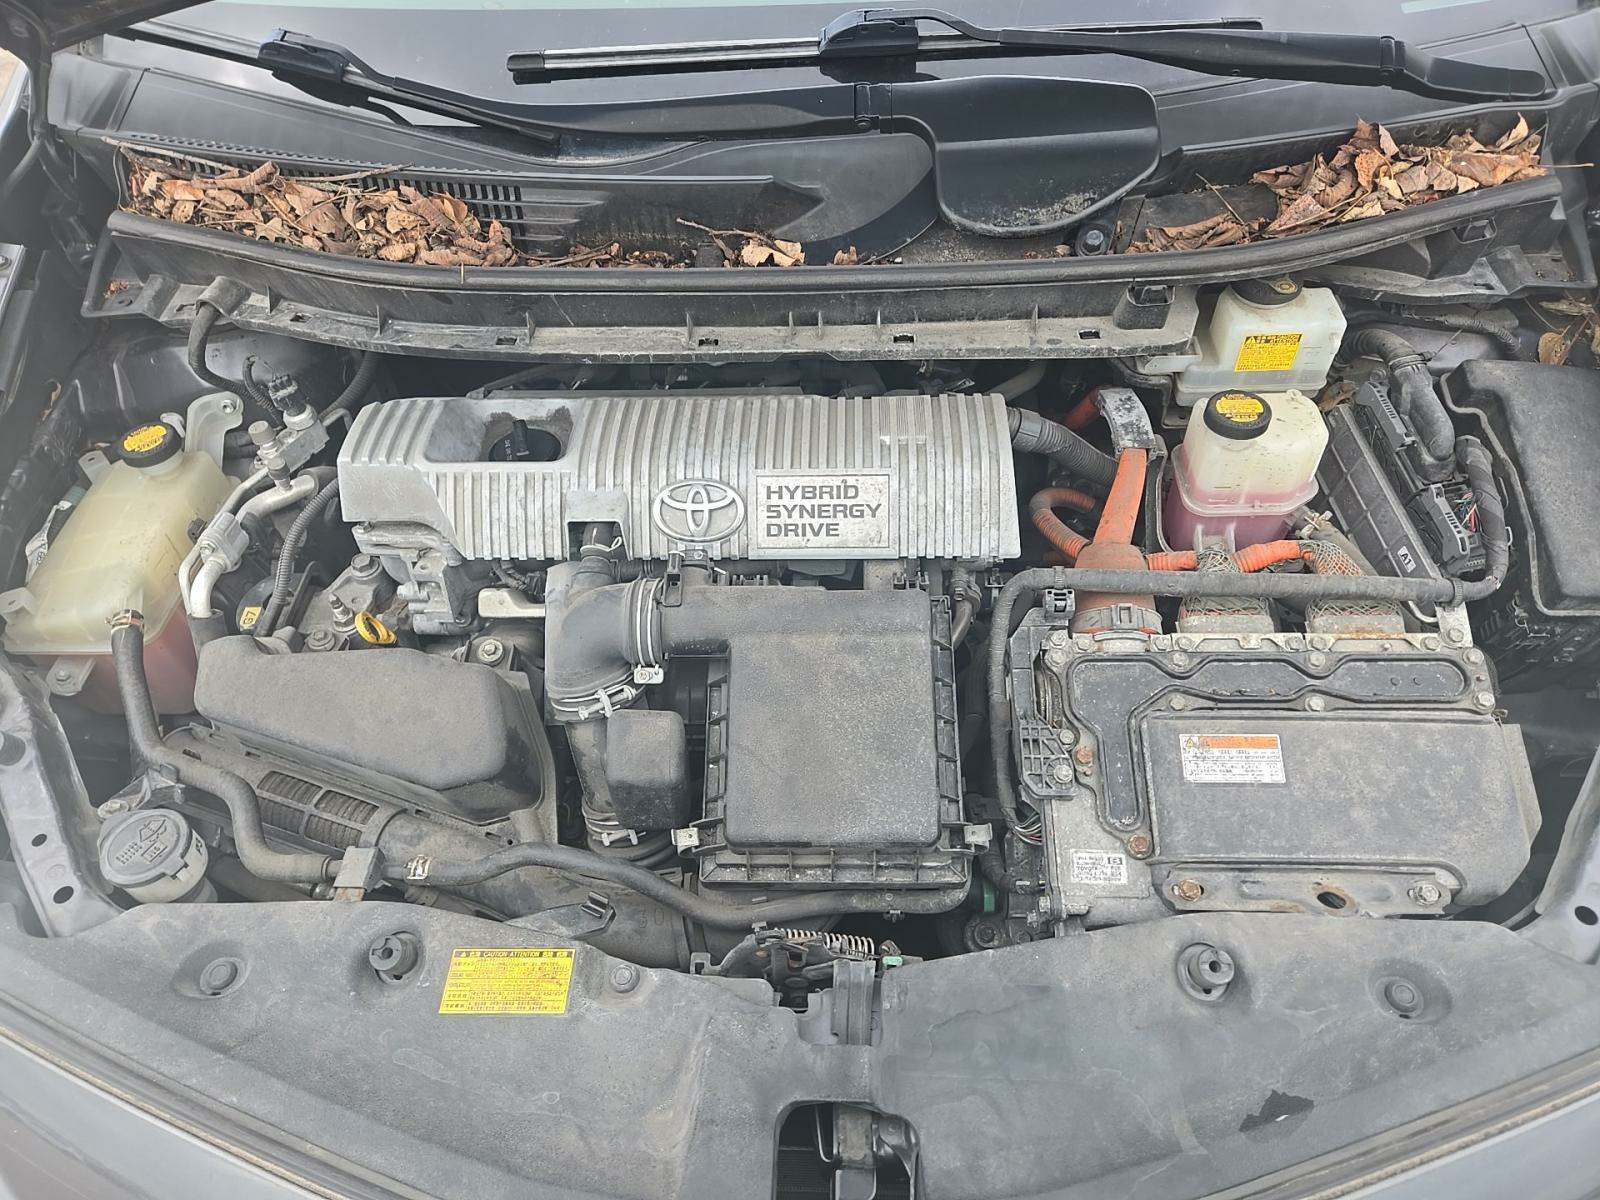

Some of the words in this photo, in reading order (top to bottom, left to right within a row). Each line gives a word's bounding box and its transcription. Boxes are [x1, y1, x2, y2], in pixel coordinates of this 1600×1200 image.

[766, 485, 859, 500] HYBRID
[766, 503, 882, 519] SYNERGY
[766, 523, 840, 537] DRIVE
[1400, 553, 1411, 565] A1
